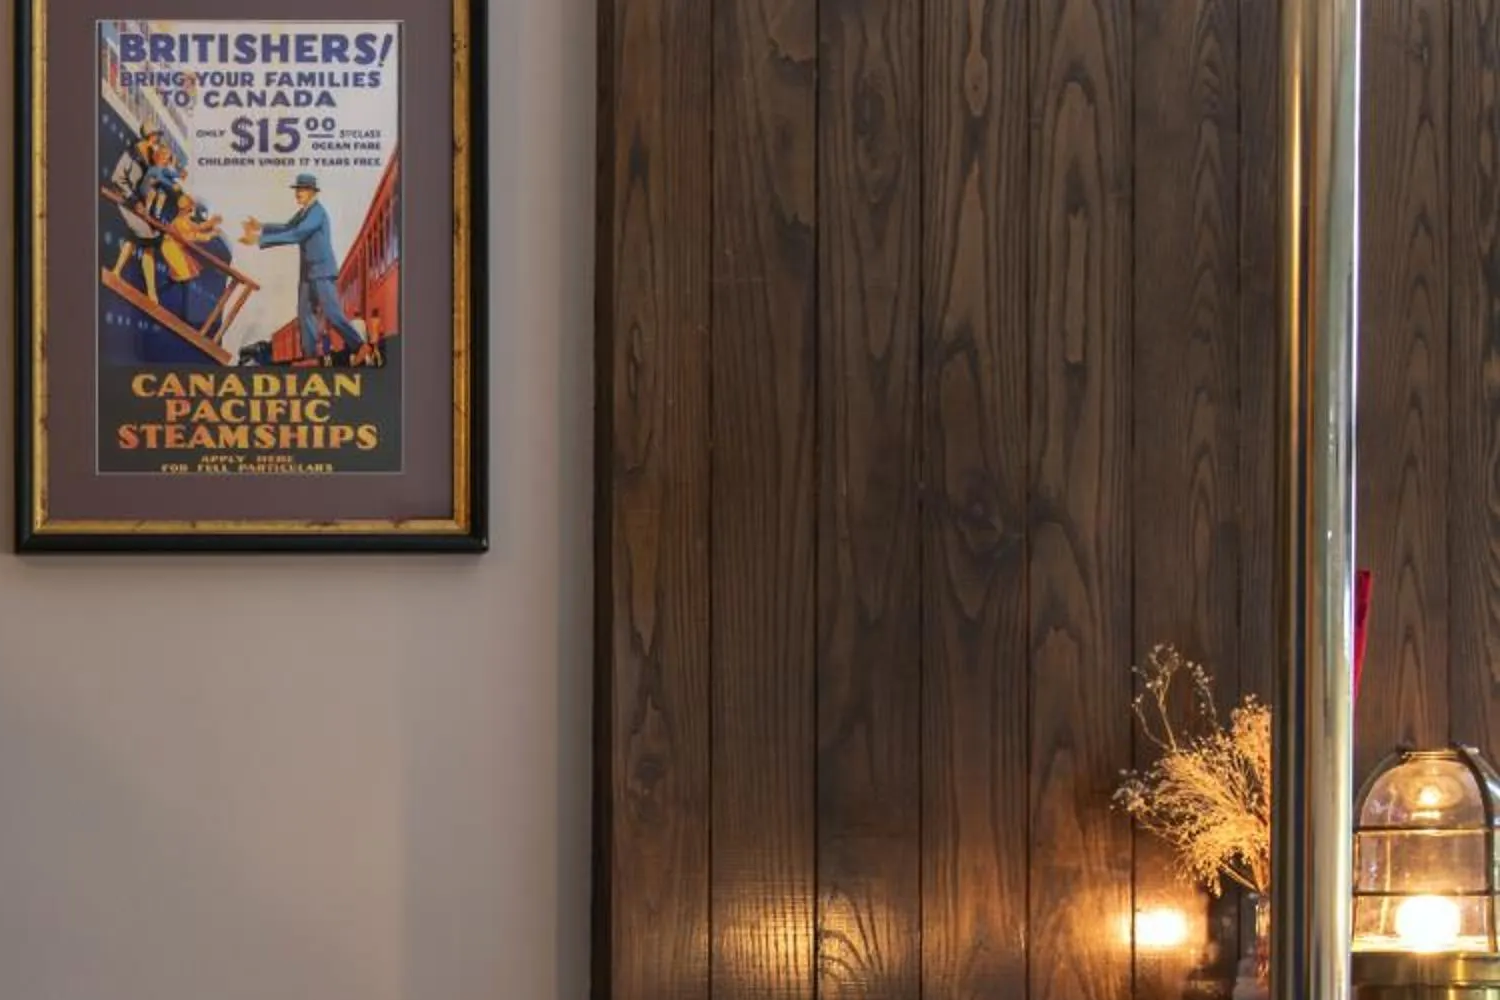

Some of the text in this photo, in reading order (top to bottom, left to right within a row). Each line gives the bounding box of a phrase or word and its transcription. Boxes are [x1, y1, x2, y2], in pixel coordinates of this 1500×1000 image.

[119, 33, 394, 68] BRITISHERS!
[119, 71, 382, 88] BRING YOUR FAMILIES
[160, 90, 337, 108] TO CANADA
[311, 142, 381, 151] OCEAN FARE
[197, 157, 255, 167] CHILDREN
[259, 157, 295, 167] UNDER
[313, 157, 350, 167] YEARS
[353, 157, 381, 167] FREE
[131, 372, 362, 398] CANADIAN
[165, 398, 332, 423] PACIFIC
[115, 423, 379, 450] STEAMSHIPS
